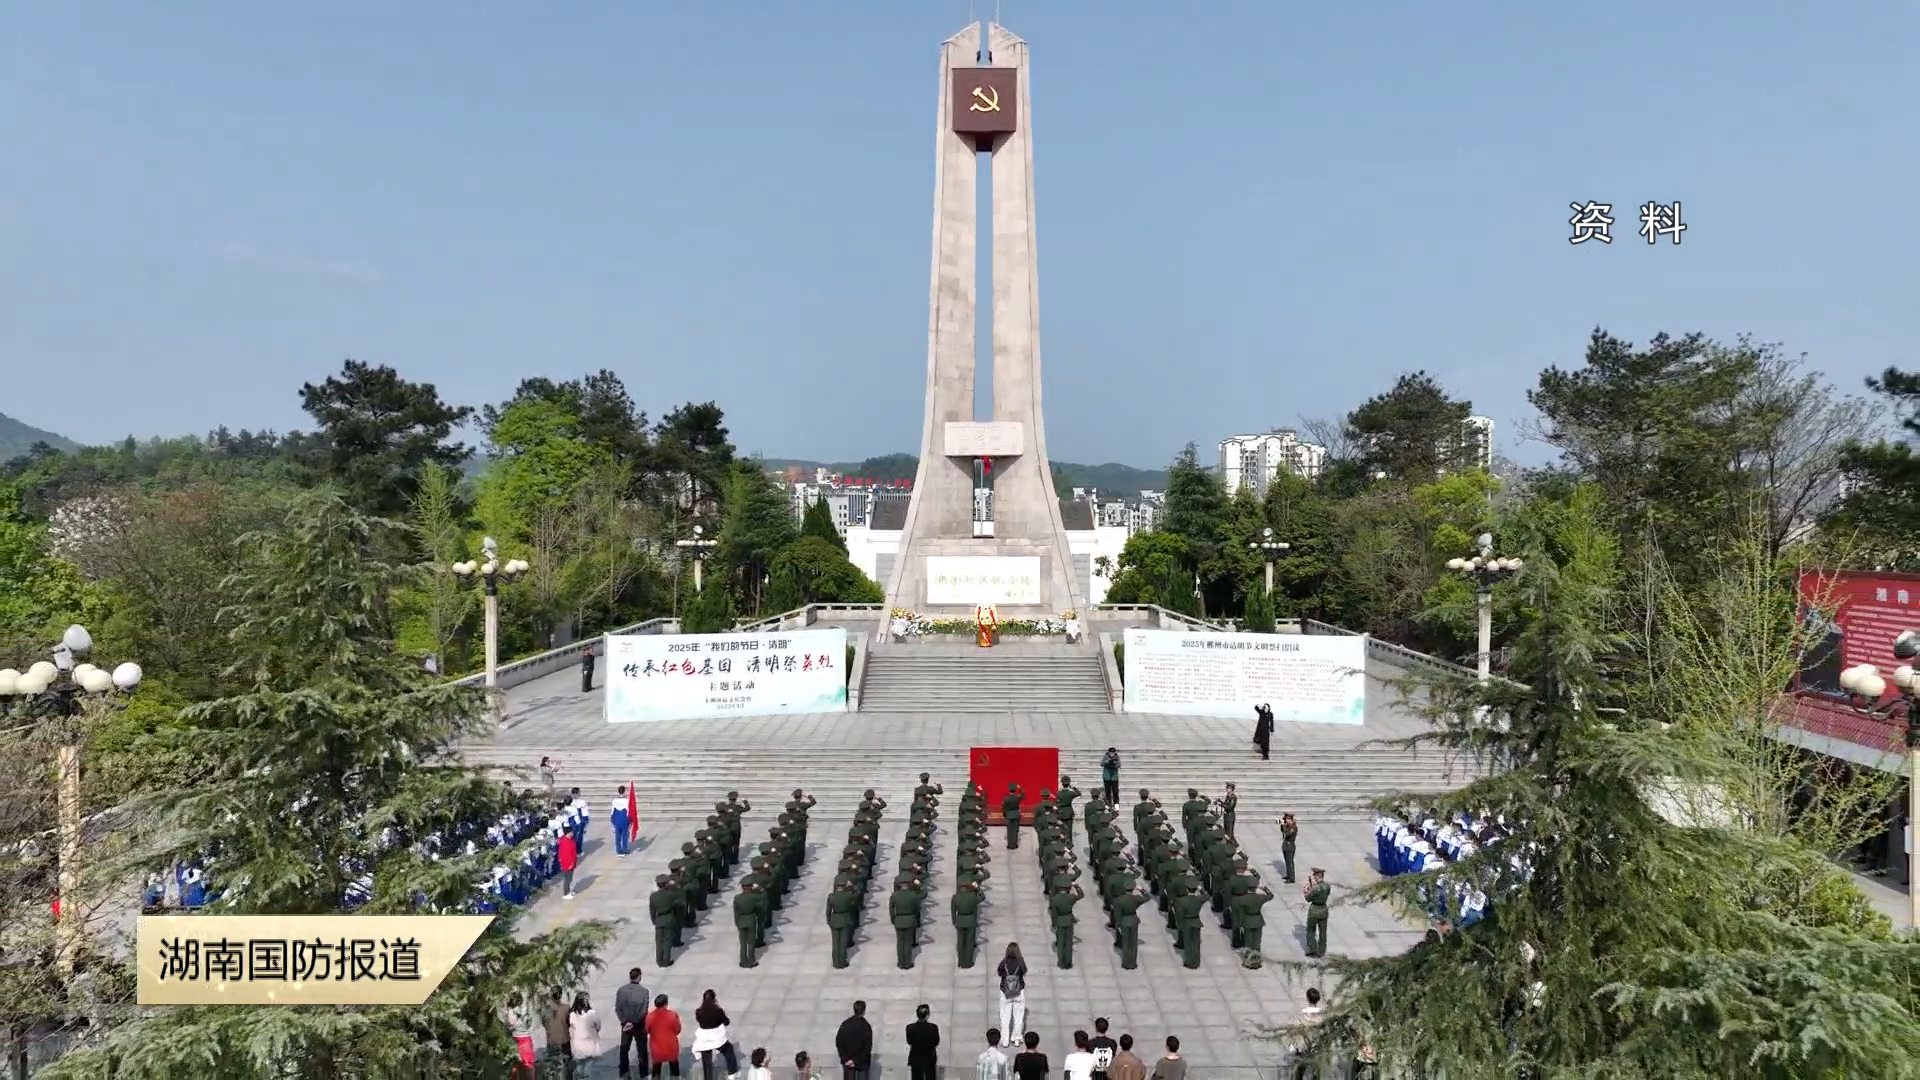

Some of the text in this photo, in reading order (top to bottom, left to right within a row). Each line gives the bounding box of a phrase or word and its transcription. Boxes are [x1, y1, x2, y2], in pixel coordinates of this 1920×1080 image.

[623, 653, 834, 678] 传承红色基因 清明祭英烈
